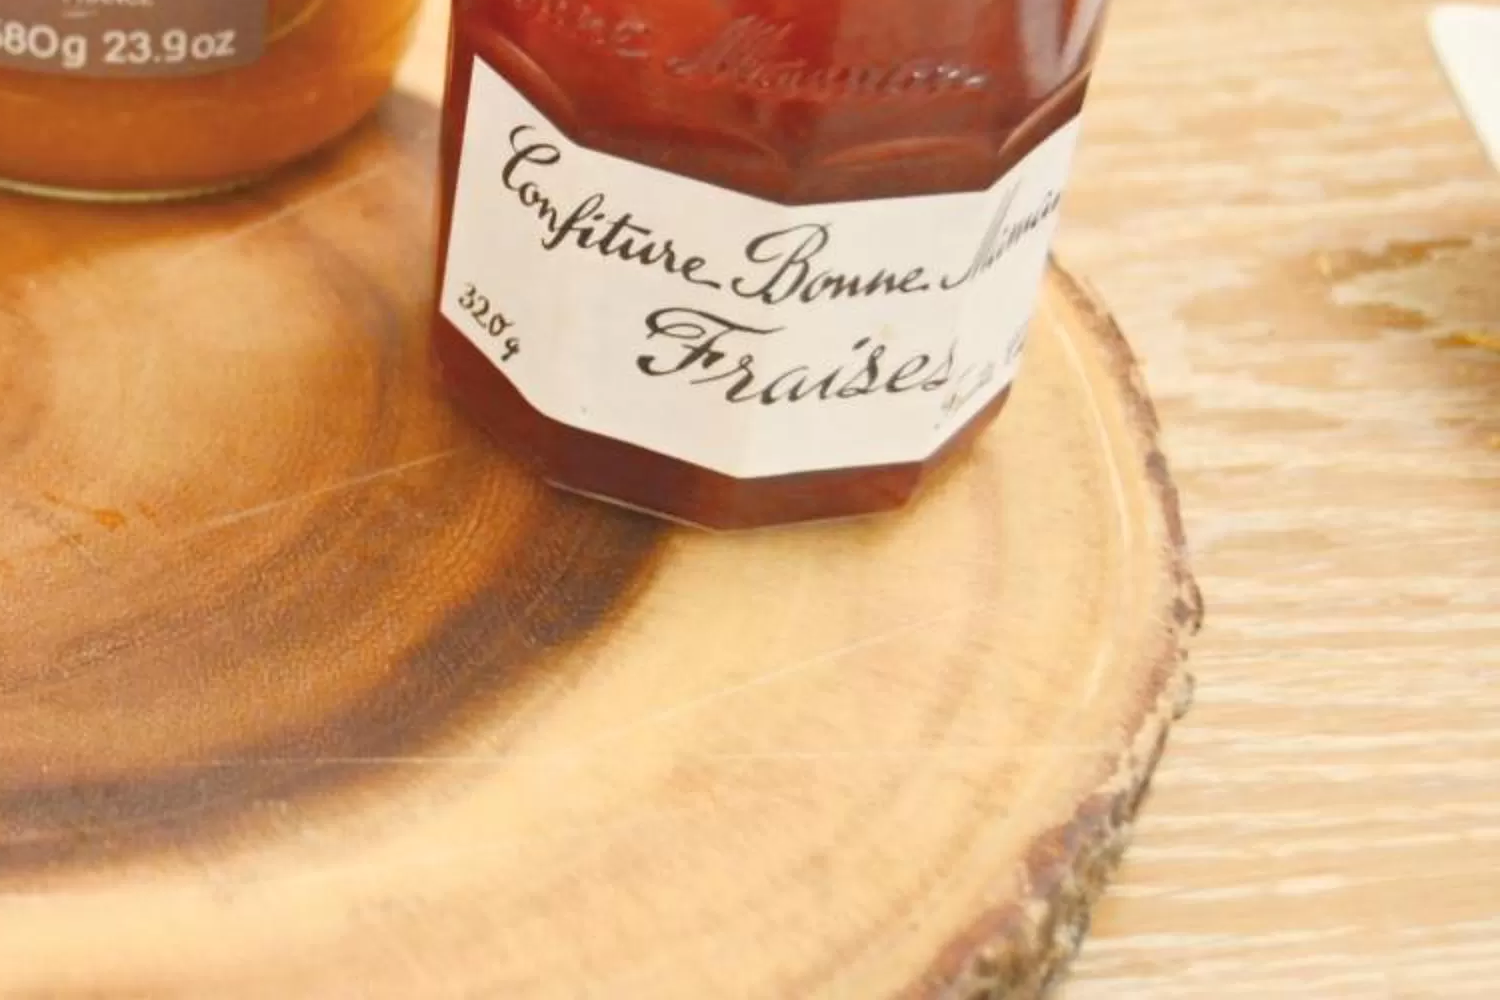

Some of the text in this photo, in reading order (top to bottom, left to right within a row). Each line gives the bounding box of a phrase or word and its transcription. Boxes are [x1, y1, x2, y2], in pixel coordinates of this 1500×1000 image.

[501, 124, 721, 291] Confiture
[731, 222, 930, 305] Bonne
[636, 306, 958, 406] Fraises
